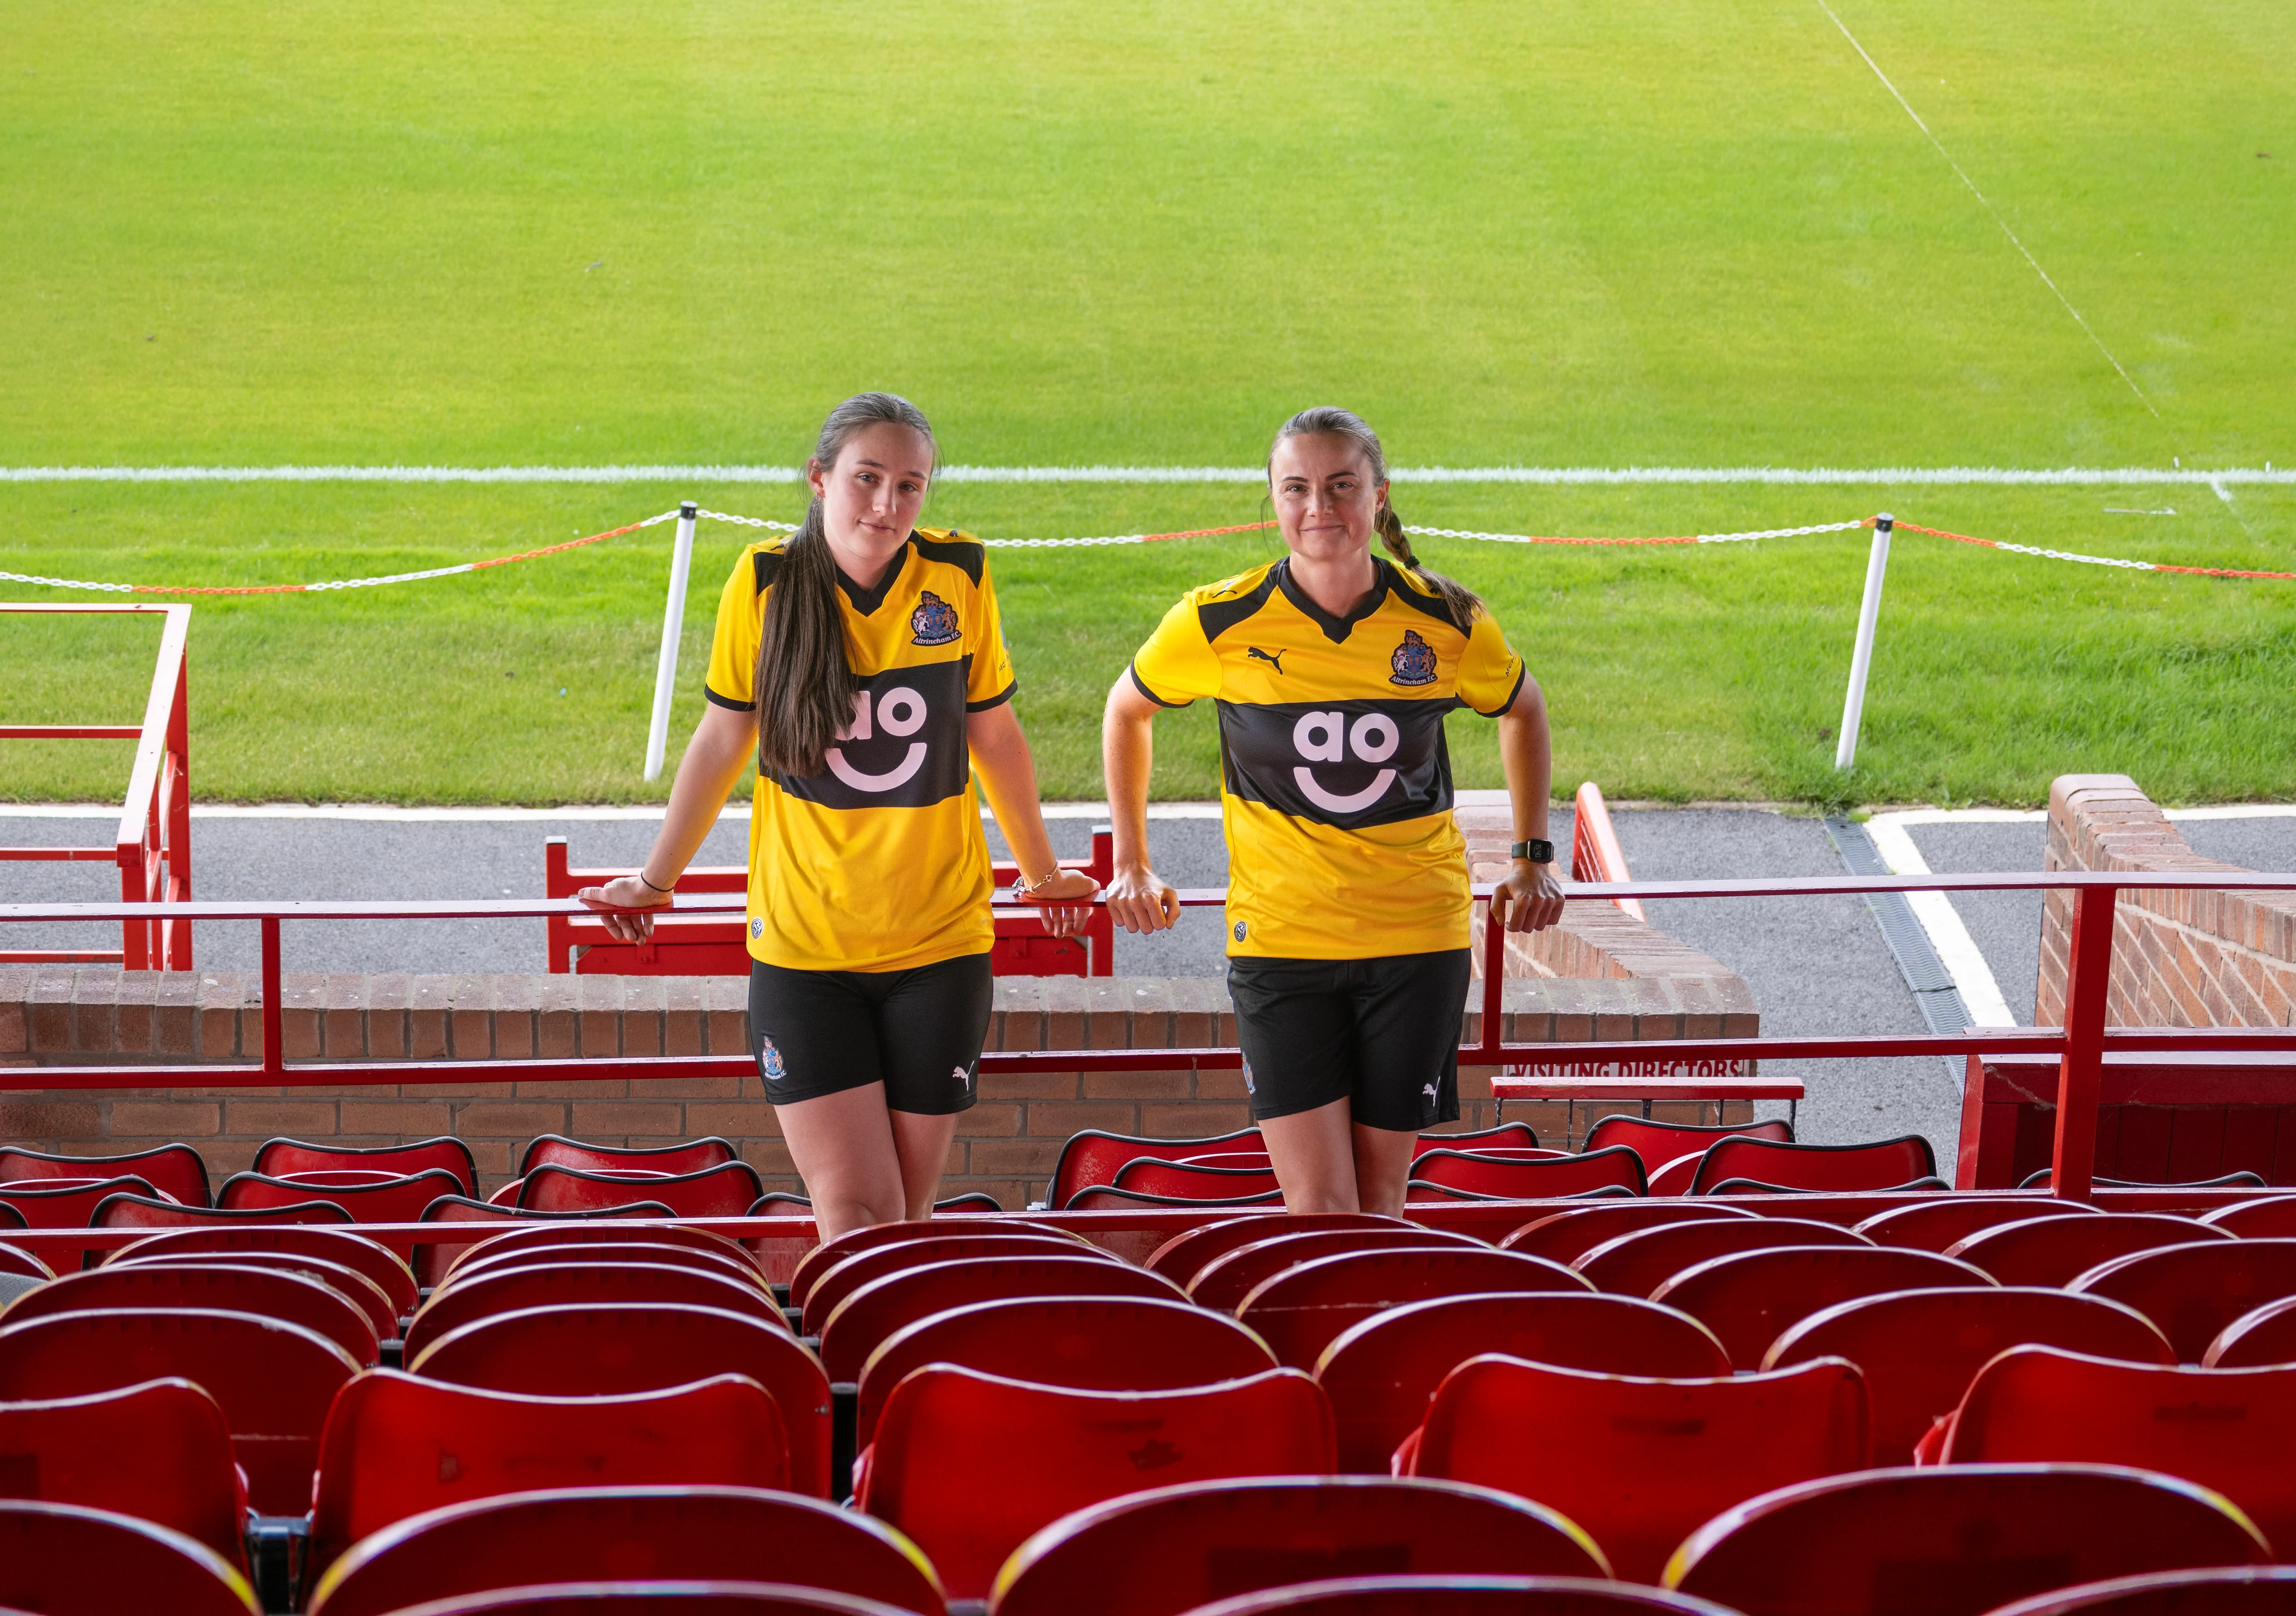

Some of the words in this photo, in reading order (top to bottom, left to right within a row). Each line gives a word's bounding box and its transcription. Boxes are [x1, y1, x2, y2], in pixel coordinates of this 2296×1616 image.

[913, 636, 951, 645] Altrincham
[951, 631, 961, 639] F.C.
[1390, 676, 1427, 685] Altrincham
[1293, 711, 1399, 763] ao
[1514, 1063, 1610, 1077] VISITING
[1618, 1059, 1739, 1077] DIRECTORS
